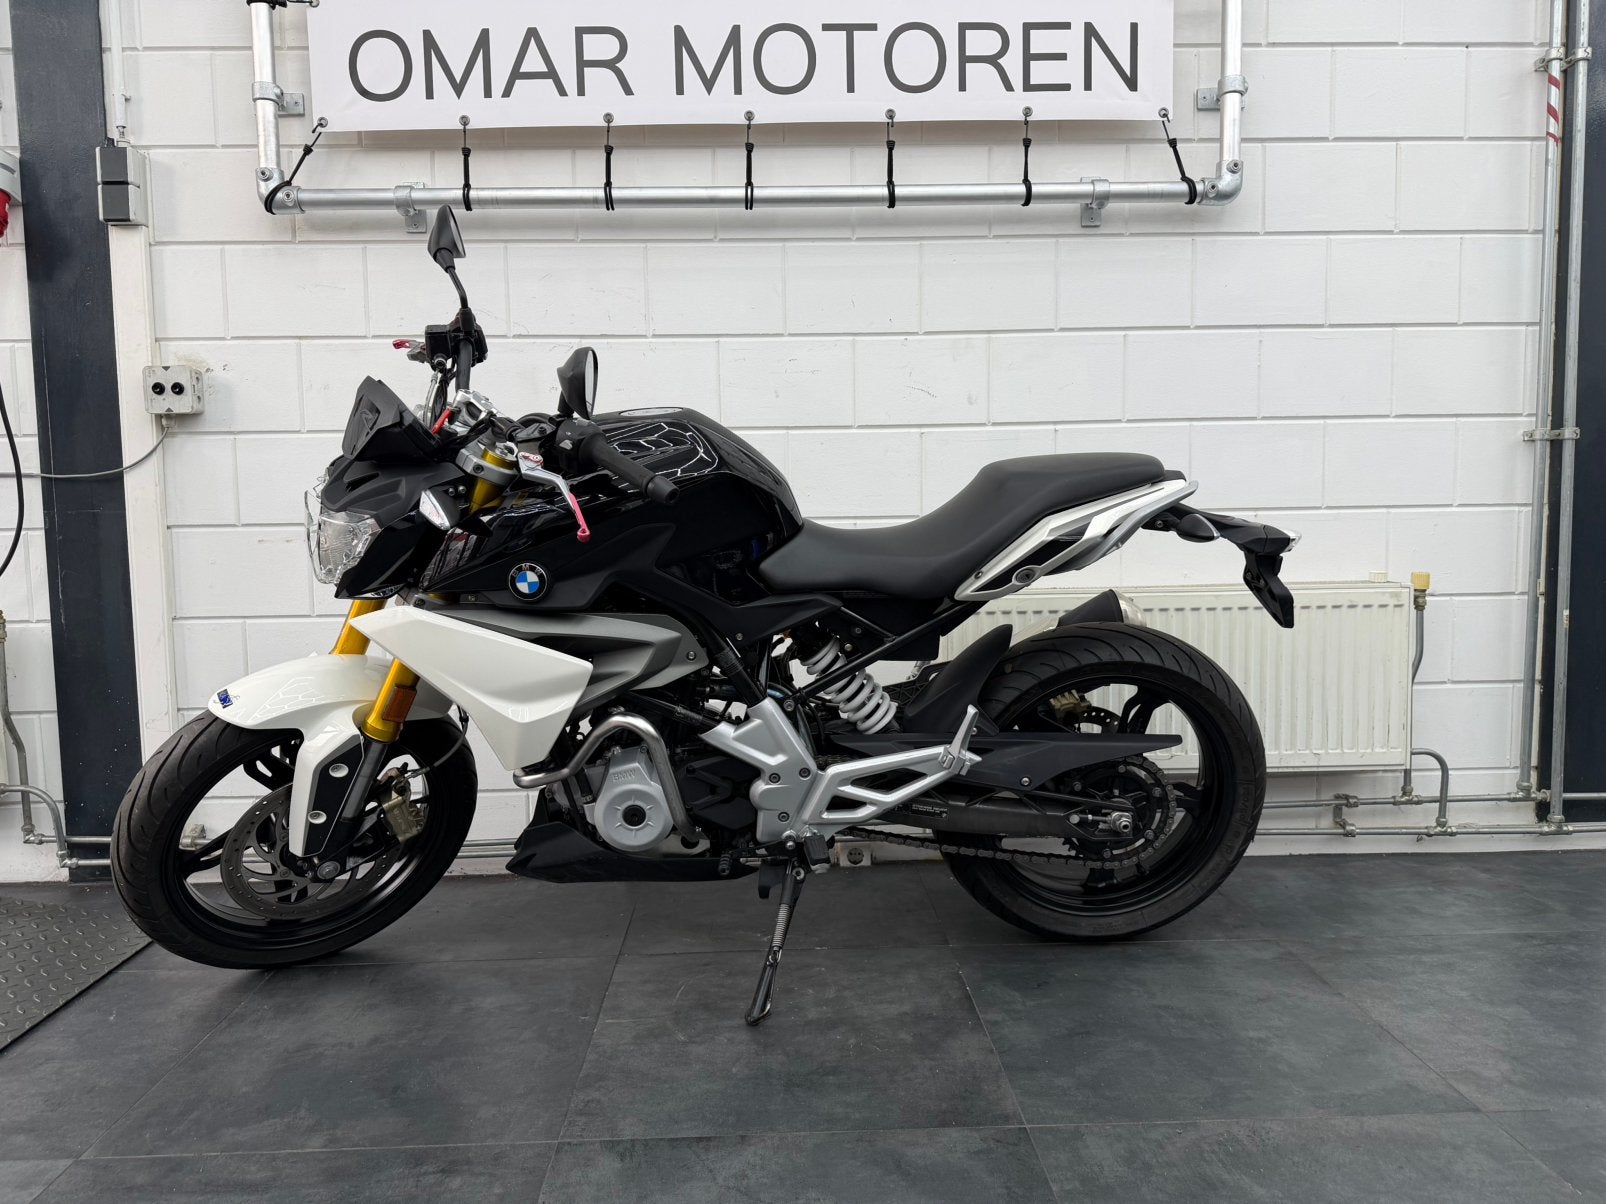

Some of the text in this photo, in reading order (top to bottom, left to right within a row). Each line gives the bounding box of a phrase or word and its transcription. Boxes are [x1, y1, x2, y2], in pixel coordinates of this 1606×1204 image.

[348, 21, 1139, 102] OMAR MOTOREN
[612, 769, 636, 782] BMW
